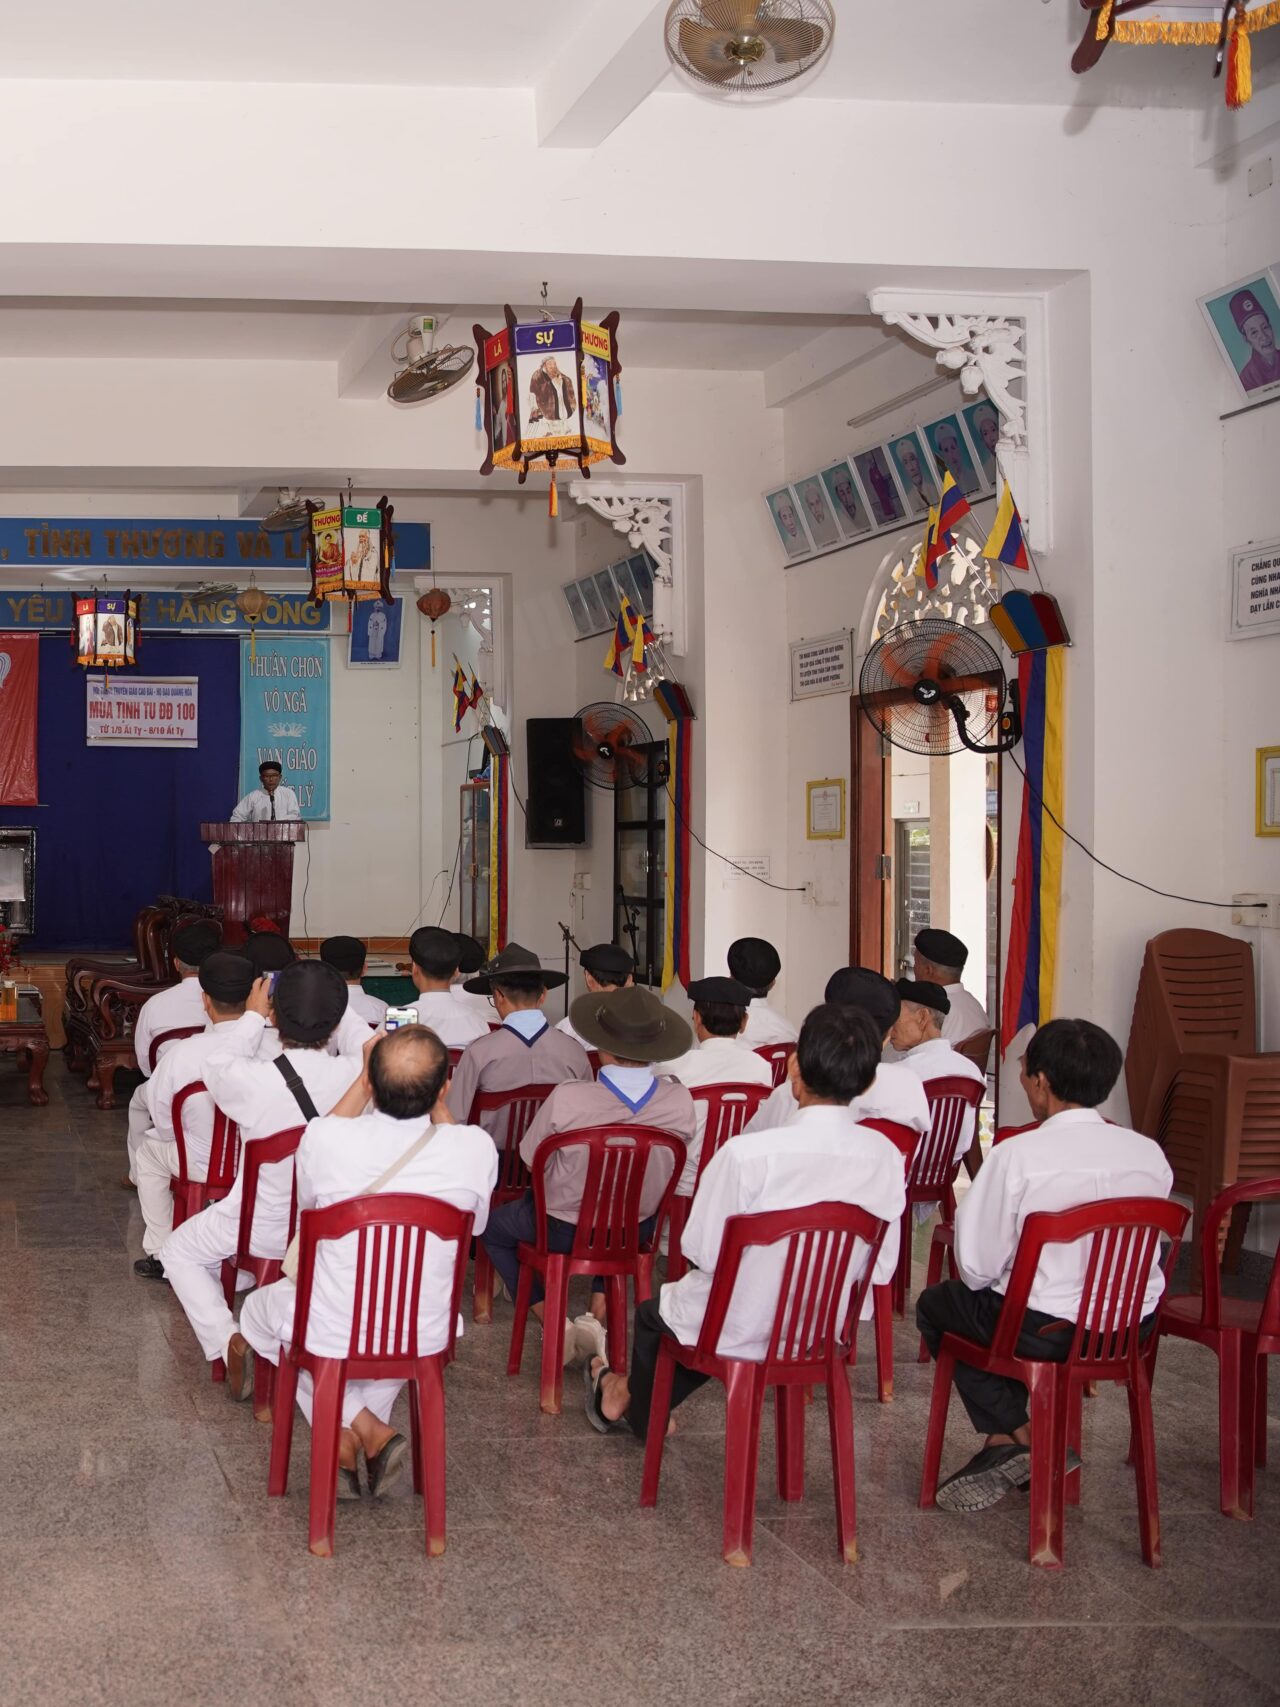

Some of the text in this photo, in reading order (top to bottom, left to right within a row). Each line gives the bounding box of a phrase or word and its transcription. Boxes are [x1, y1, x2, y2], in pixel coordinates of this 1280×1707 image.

[535, 328, 555, 347] SỰ
[356, 512, 368, 523] ĐẾ
[25, 522, 91, 558] TÌNH
[104, 527, 224, 560] THƯƠNG
[89, 697, 113, 719] MÙA
[116, 701, 140, 723] TỊNH
[176, 703, 196, 721] 100
[264, 687, 281, 713] VÔ
[287, 742, 317, 771] GIÁO
[299, 781, 314, 808] LÝ
